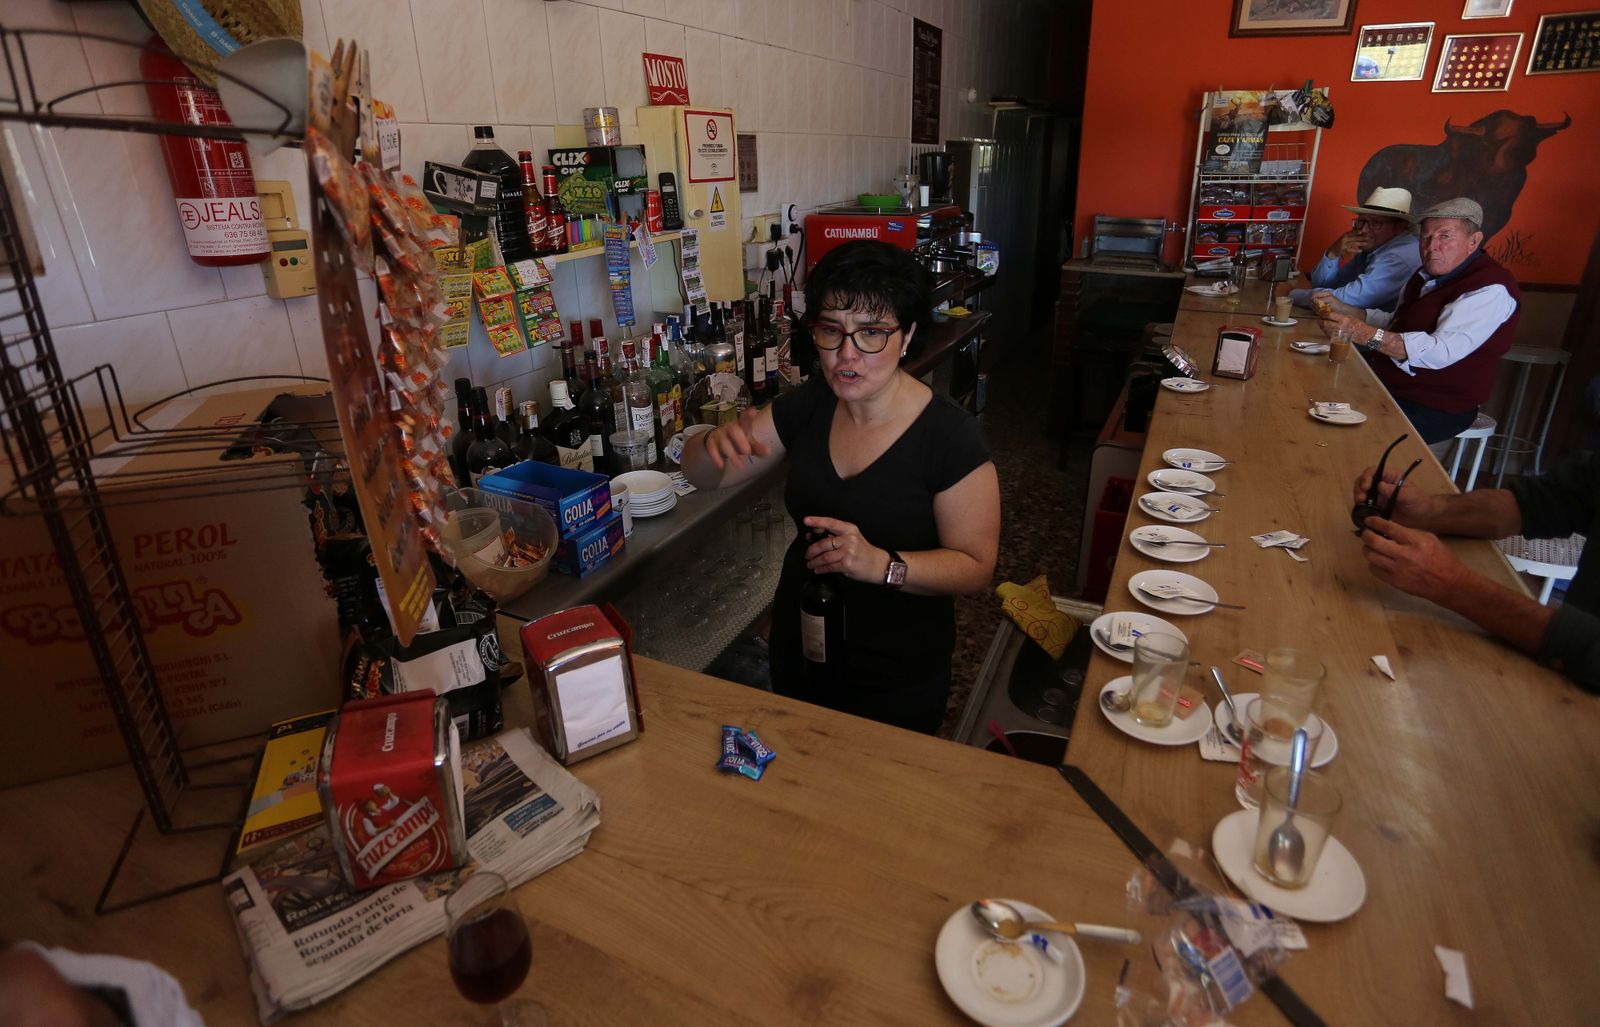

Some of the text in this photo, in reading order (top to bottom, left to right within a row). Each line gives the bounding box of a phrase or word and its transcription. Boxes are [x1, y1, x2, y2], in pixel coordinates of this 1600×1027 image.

[644, 58, 687, 90] MOSTO
[224, 231, 239, 239] 636
[239, 230, 249, 238] 75
[824, 226, 879, 239] CATUNAMBÚ
[564, 497, 594, 525] GOLIA
[133, 522, 237, 559] PEROL
[581, 535, 609, 563] GOLIA
[134, 549, 228, 573] NATURAL 100%
[547, 620, 596, 641] Cruzcampo
[381, 711, 397, 752] Cruzcampo
[750, 739, 769, 758] GOLIA
[286, 900, 326, 923] Real
[293, 883, 407, 949] Rotunda tarde de
[299, 901, 396, 959] Roca Rey en la
[305, 903, 415, 968] segunda de feria
